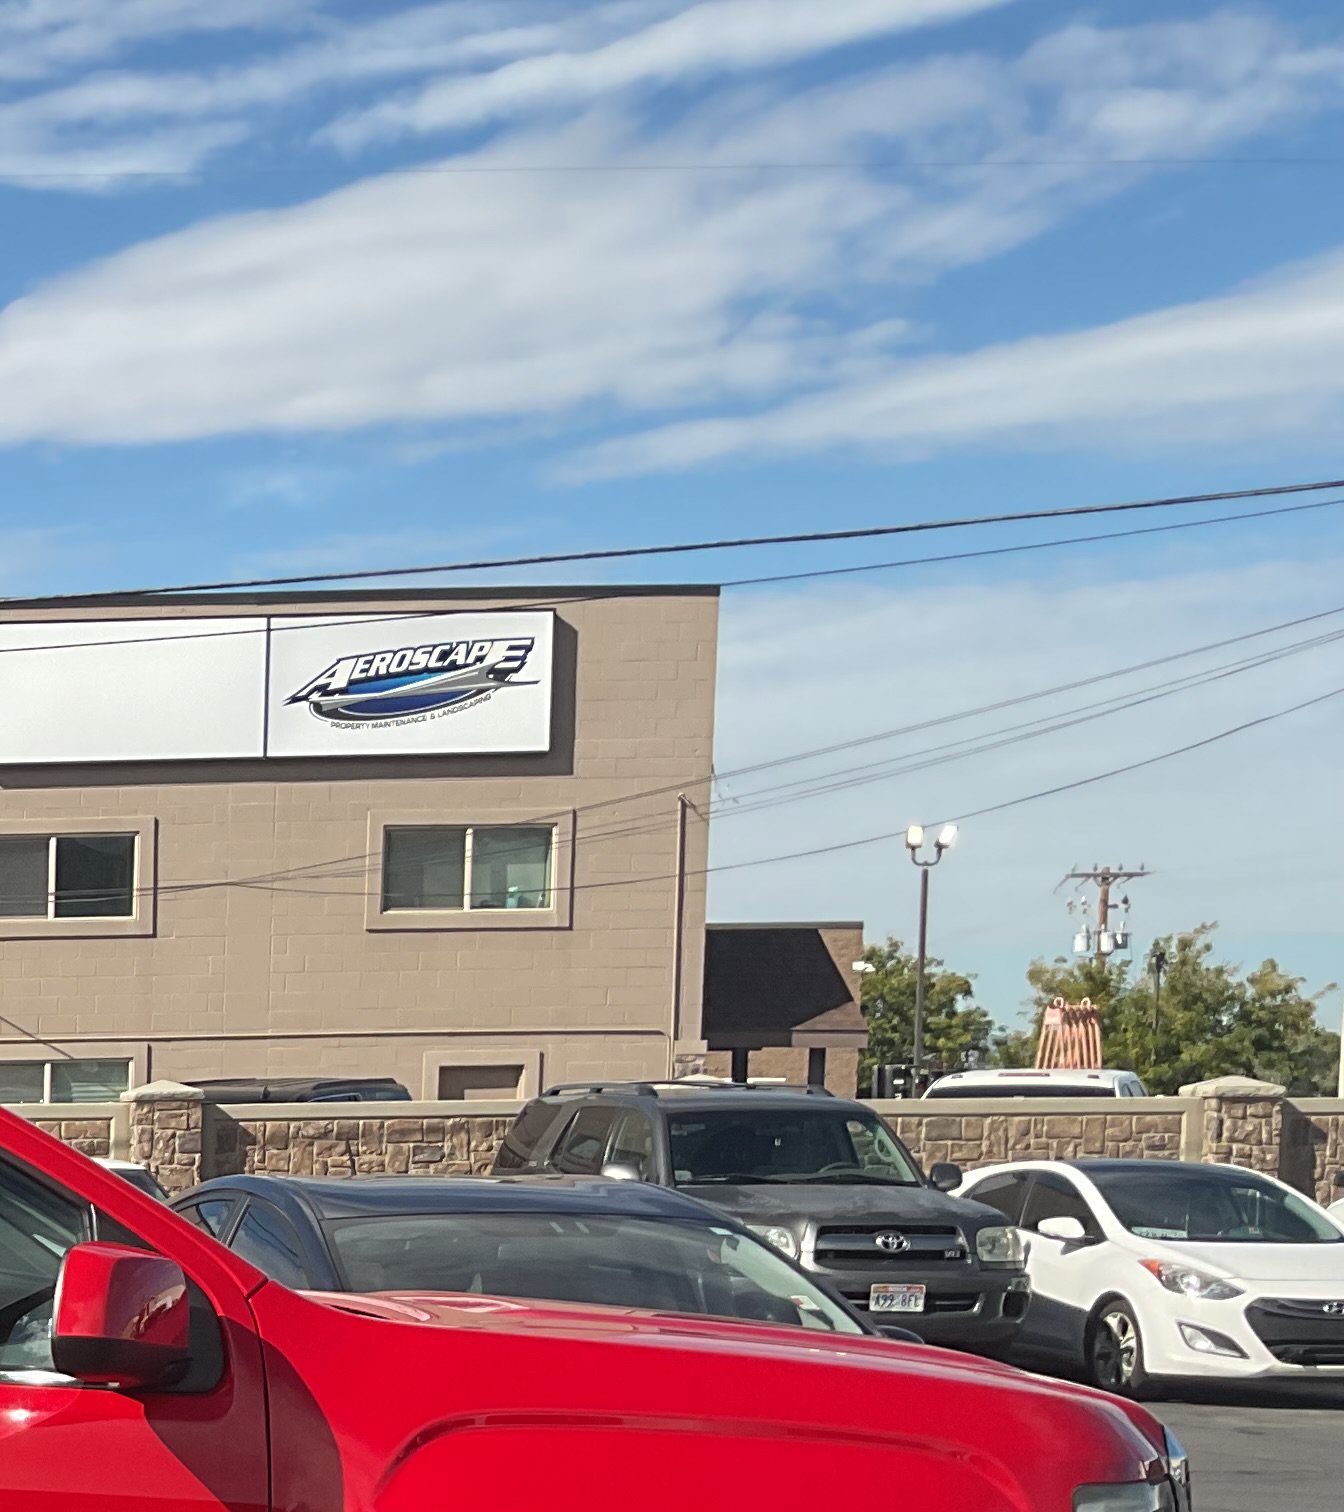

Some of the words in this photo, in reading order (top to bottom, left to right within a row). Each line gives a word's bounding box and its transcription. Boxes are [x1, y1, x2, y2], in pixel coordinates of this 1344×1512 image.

[285, 636, 536, 704] AEROSCAPE
[329, 720, 370, 731] PROPERTY
[371, 713, 427, 730] MAINTENANCE
[437, 693, 492, 718] LANDSCAPING
